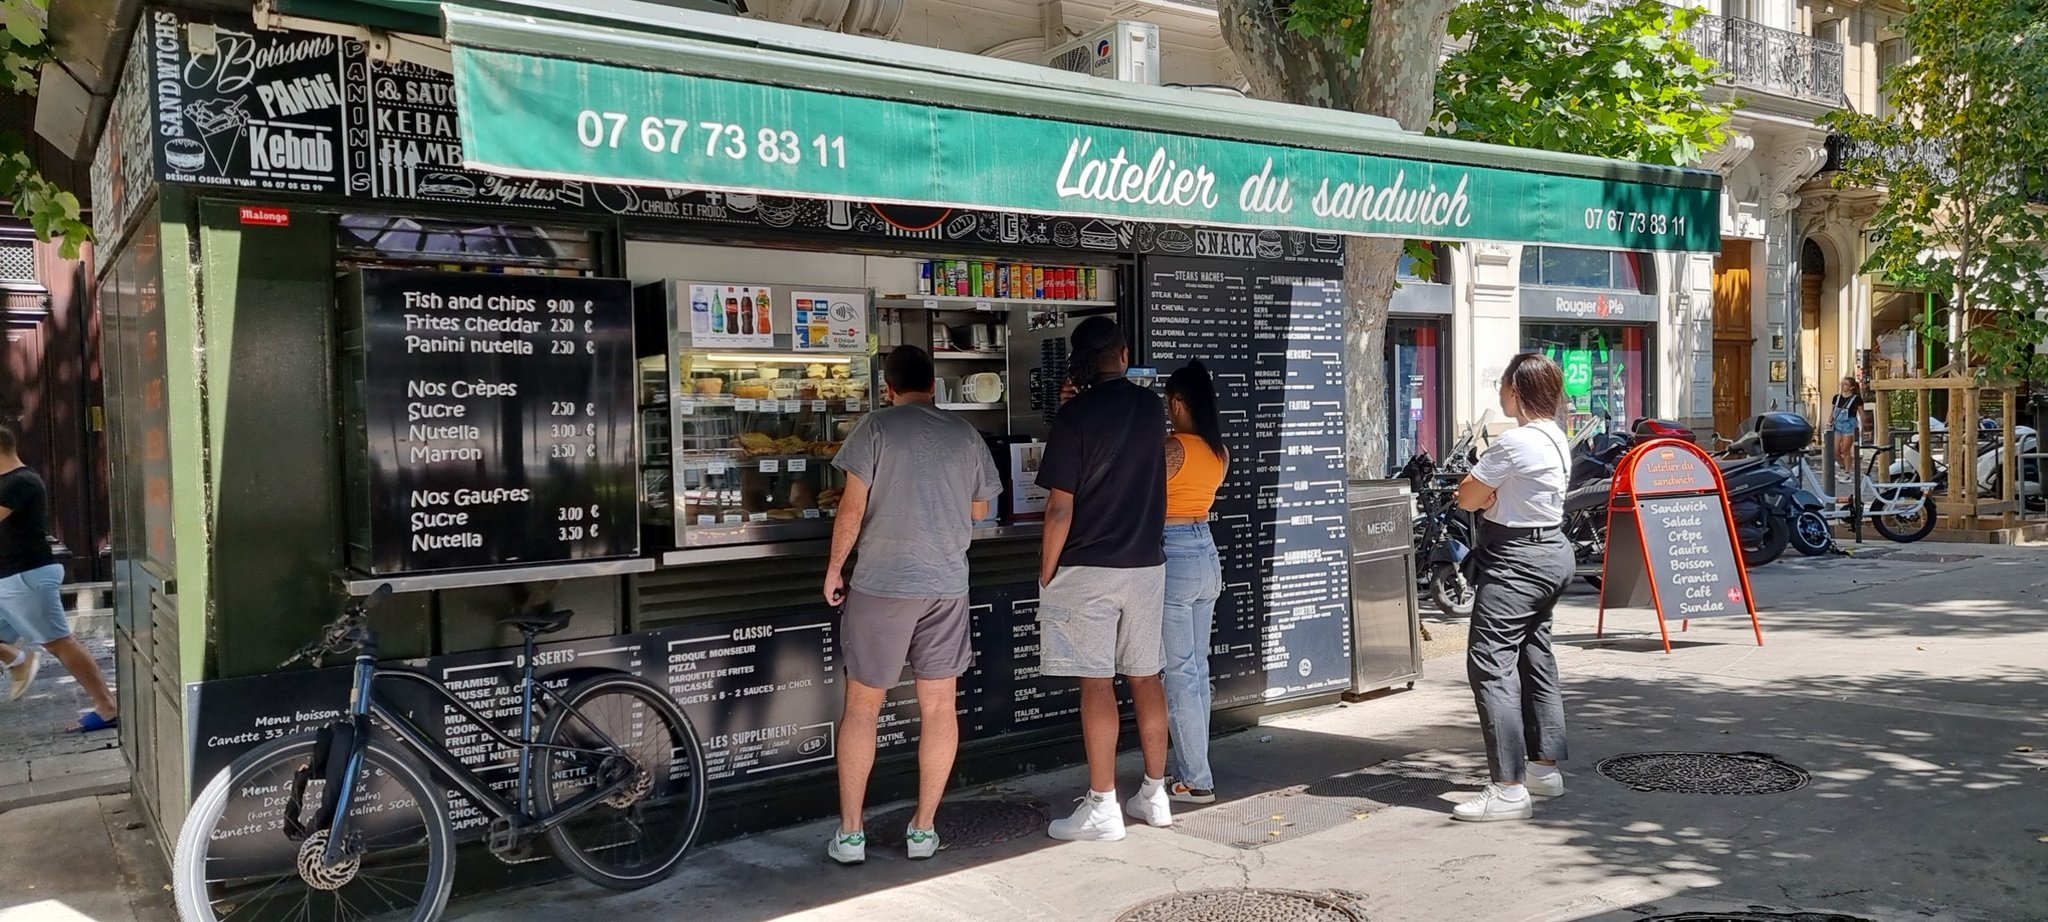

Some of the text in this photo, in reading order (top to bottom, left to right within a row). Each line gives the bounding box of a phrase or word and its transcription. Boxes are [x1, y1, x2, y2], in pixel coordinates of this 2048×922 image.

[183, 33, 336, 93] Boissons
[154, 11, 184, 137] SANDWICHS
[377, 108, 461, 138] KEBA
[577, 109, 846, 169] 07 67 73 83 11
[250, 125, 333, 173] Kebab
[165, 173, 196, 182] DESIGN
[233, 178, 257, 186] YVAN
[1056, 135, 1471, 228] L'atelier du sandwich
[241, 209, 288, 223] Malongo
[641, 199, 728, 219] CHAUDS ET FROIDS
[1584, 208, 1685, 236] 07 67 73 83 11
[1197, 231, 1254, 257] SNACK
[1175, 271, 1198, 281] STEAKS
[403, 291, 443, 310] Fish
[448, 294, 483, 310] and
[487, 295, 536, 313] chips
[1556, 297, 1595, 317] Rougier
[403, 314, 461, 332] Frites
[464, 316, 542, 334] cheddar
[404, 335, 465, 354] Panini
[470, 338, 534, 355] nutella
[408, 380, 448, 399] Nos
[408, 402, 466, 422] Sucre
[409, 424, 480, 442] Nutella
[410, 445, 483, 464] Marron
[1682, 460, 1694, 470] du
[1653, 474, 1695, 486] sandwich
[410, 488, 531, 509] Nos Gaufres
[1650, 500, 1708, 514] Sandwich
[411, 512, 469, 532] Sucre
[1662, 515, 1701, 528] Salade
[411, 532, 484, 552] Nutella
[1669, 542, 1709, 556] Gaufre
[1670, 558, 1714, 570] Boisson
[1673, 571, 1719, 585] Granita
[1686, 585, 1712, 599] Café
[1680, 600, 1724, 614] Sundae
[733, 625, 773, 641] CLASSIC
[668, 645, 756, 664] CROQUE MONSIEUR
[1013, 644, 1039, 653] MARIUS
[517, 649, 575, 668] DSSERTS
[668, 662, 697, 673] PIZZA
[668, 665, 754, 684] BARQUETTE DE FRITES
[495, 686, 510, 696] AU
[669, 679, 714, 695] FRICASSÉ
[675, 693, 709, 706] UGGETS
[719, 691, 726, 700] 8
[735, 689, 741, 698] 2
[743, 684, 774, 696] SAUCES
[788, 680, 812, 689] CHOIX
[1014, 688, 1037, 697] CESAR
[255, 715, 291, 728] Menu
[295, 709, 340, 722] boisson
[1014, 708, 1040, 718] ITALIEN
[207, 728, 284, 748] Canette 33
[445, 734, 478, 747] FRUIT
[710, 723, 798, 749] LES SUPPLEMENTS
[803, 738, 821, 752] 0.50
[447, 743, 494, 757] EIGNET
[241, 784, 278, 798] Menu
[211, 824, 263, 841] Canette
